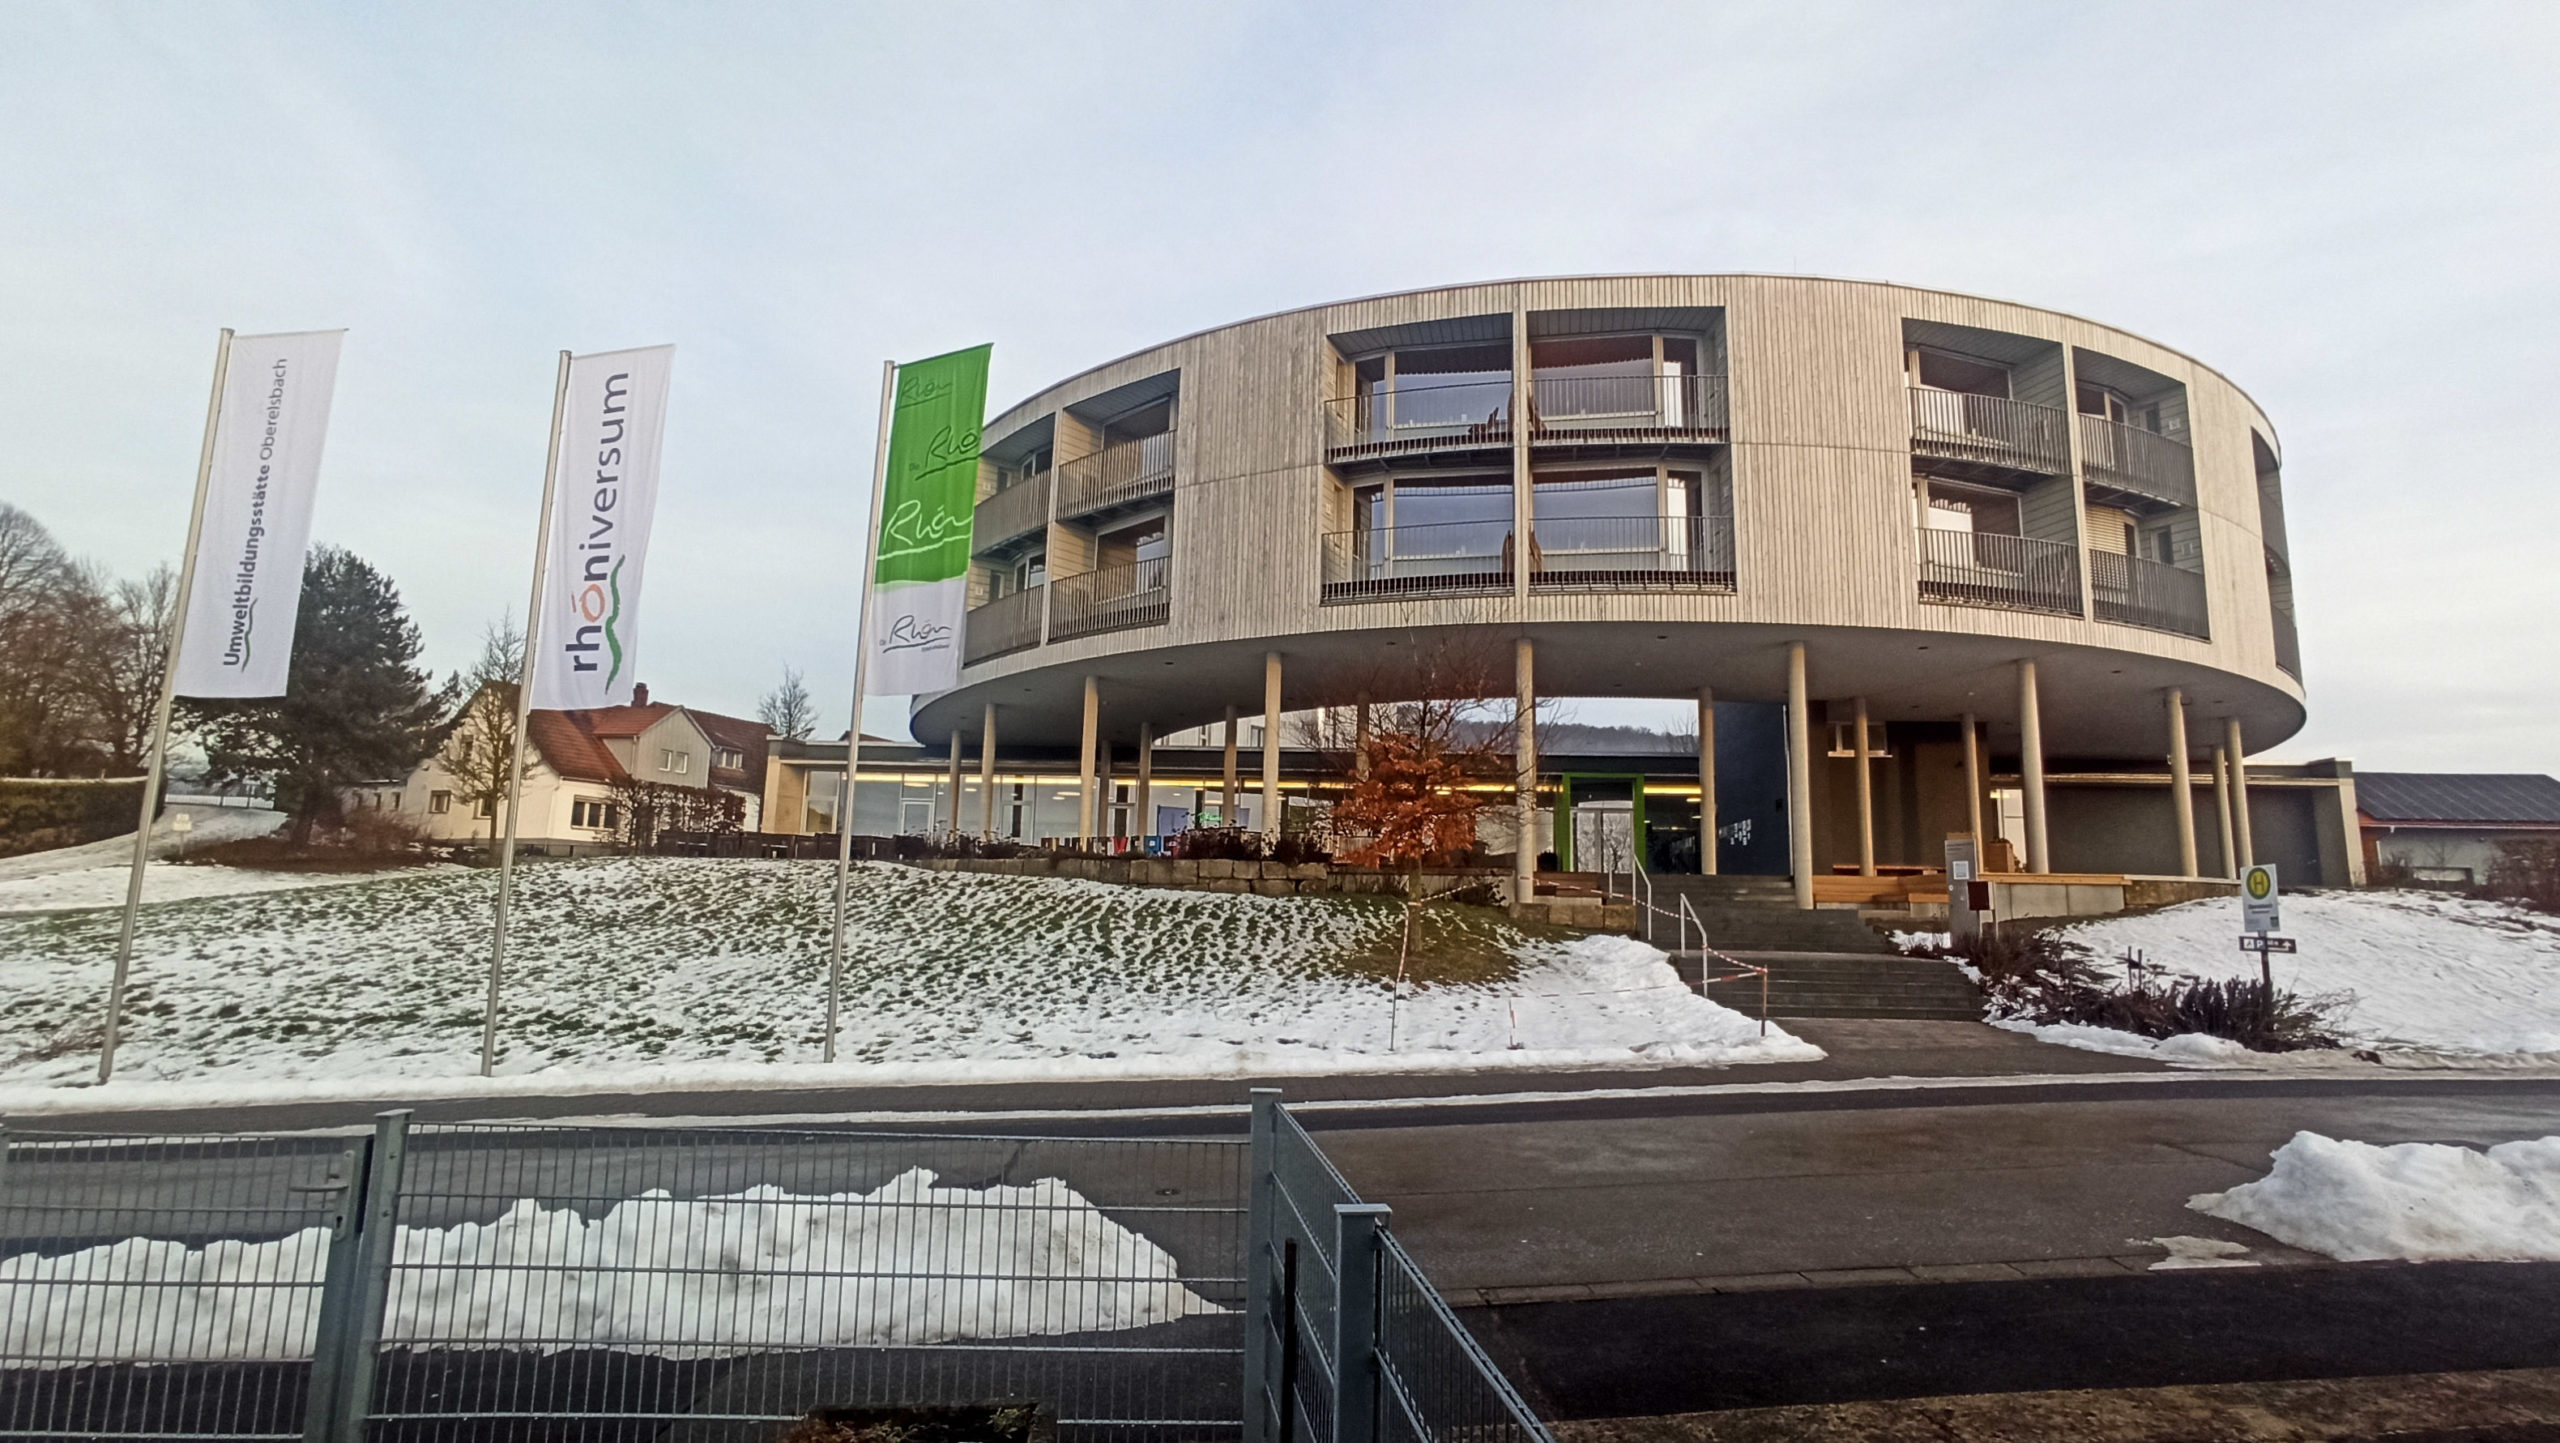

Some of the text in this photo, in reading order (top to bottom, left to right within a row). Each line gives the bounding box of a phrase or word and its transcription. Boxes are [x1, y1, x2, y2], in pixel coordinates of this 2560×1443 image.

[223, 358, 288, 666] Umweltbildungsstätte Oberelsbach
[889, 613, 952, 644] Rhön
[2253, 873, 2265, 891] H
[2256, 940, 2264, 948] P
